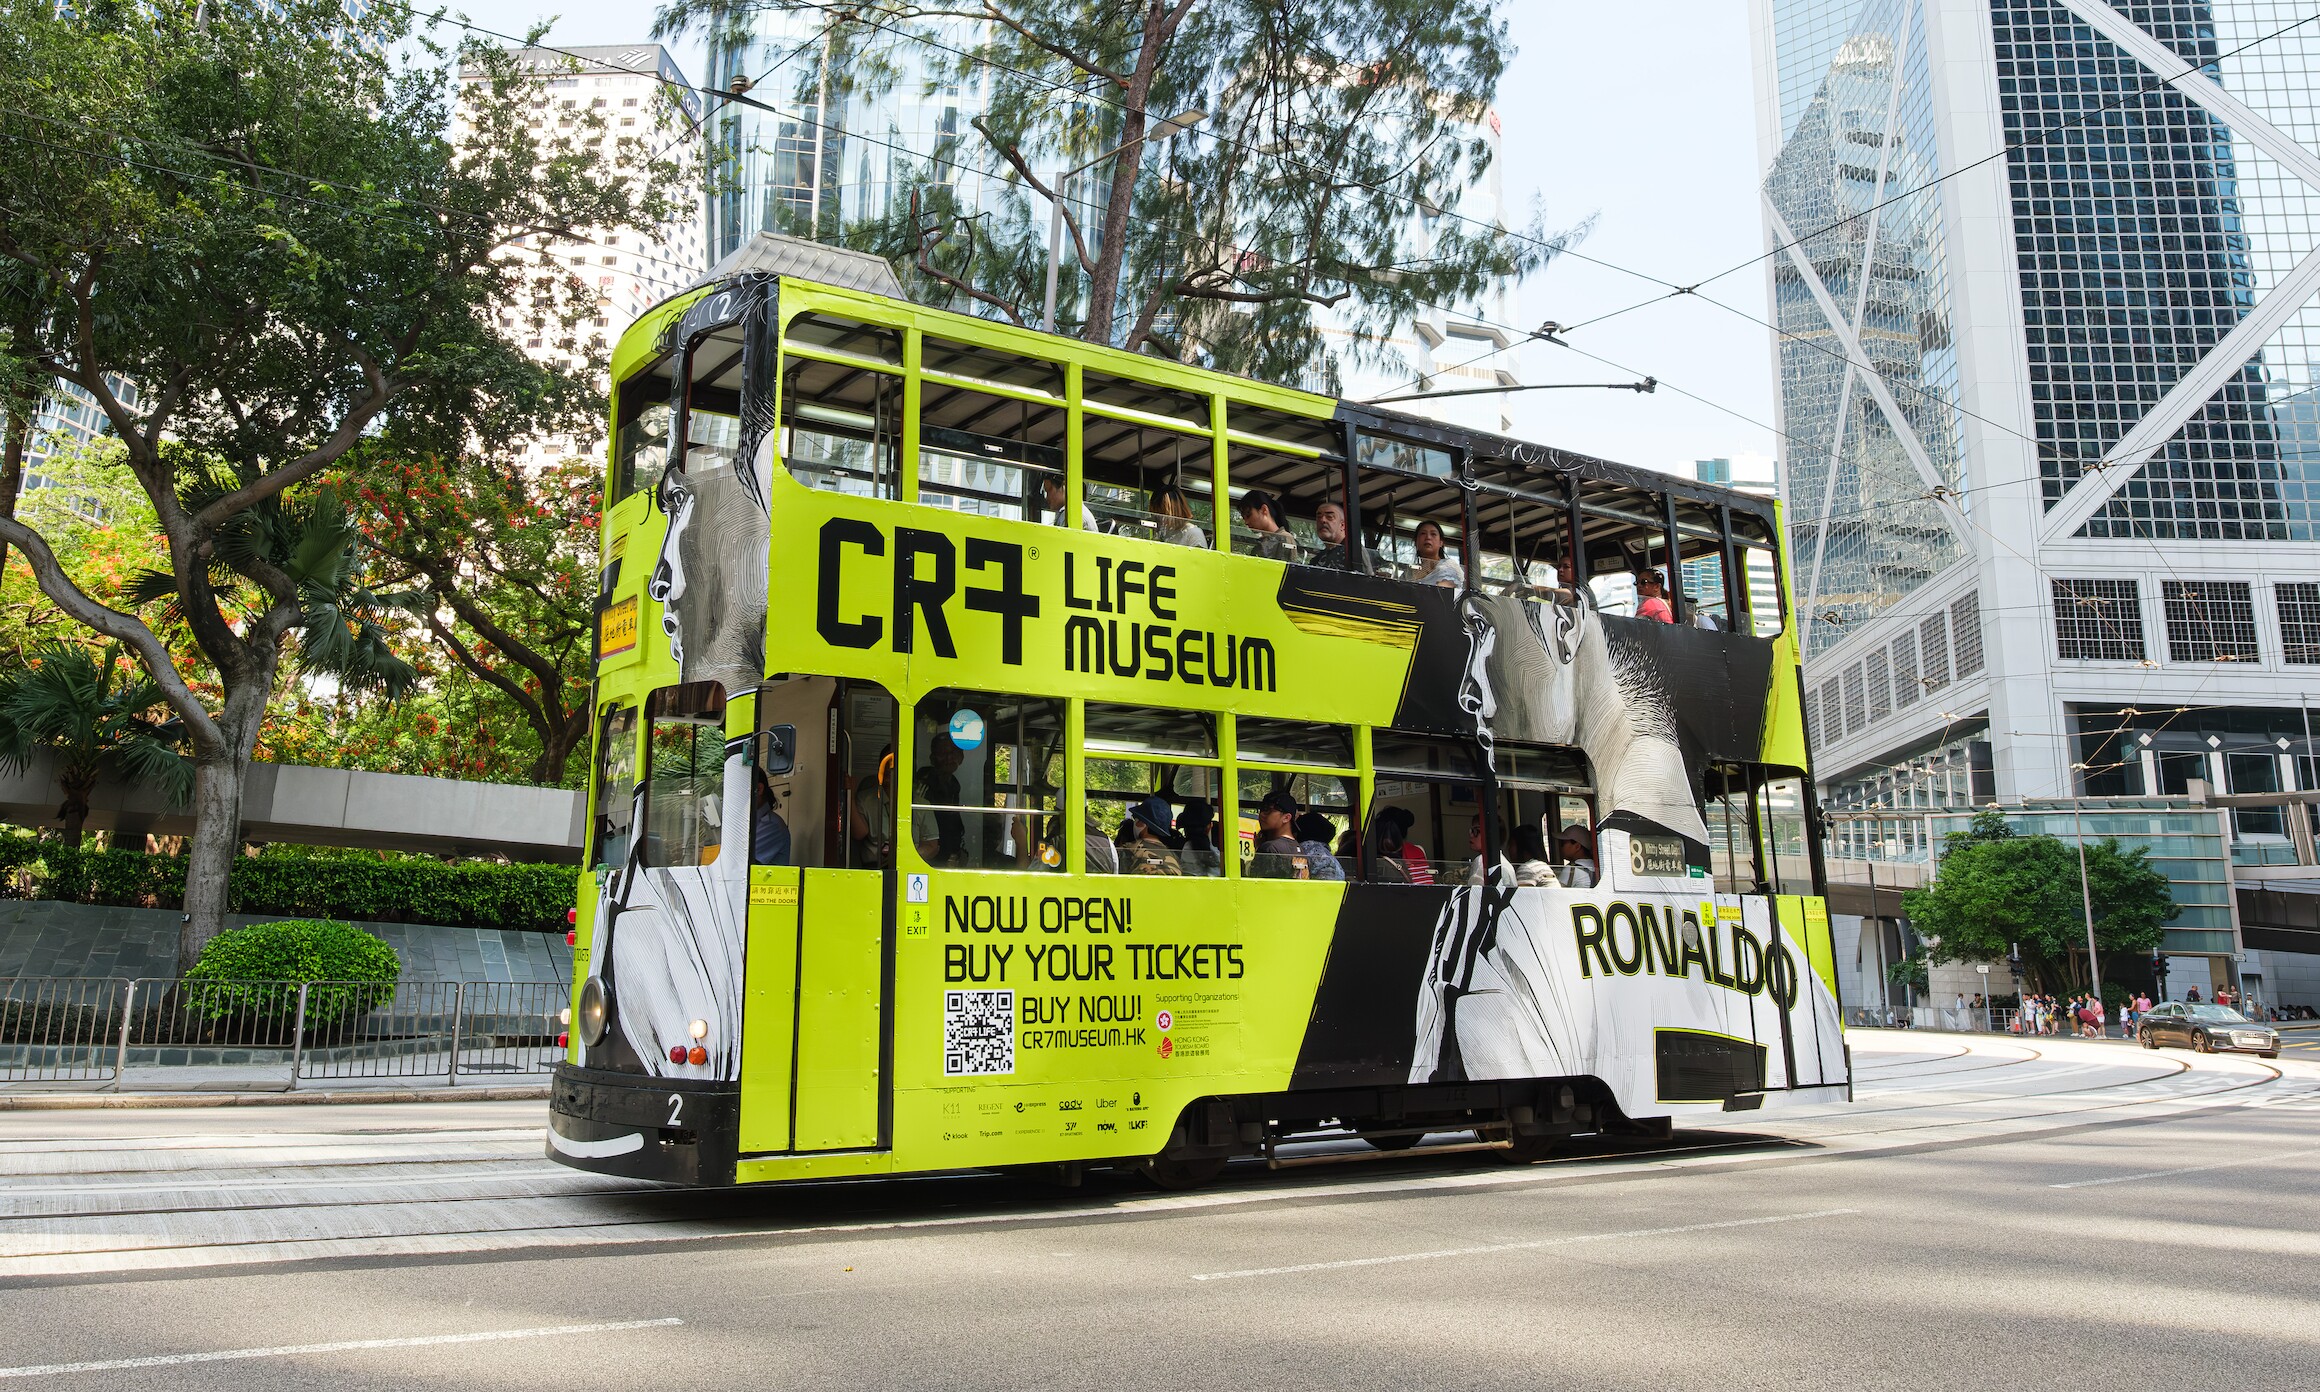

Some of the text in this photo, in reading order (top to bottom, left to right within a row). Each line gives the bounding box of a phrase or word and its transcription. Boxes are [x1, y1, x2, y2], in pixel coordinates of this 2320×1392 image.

[717, 293, 732, 321] 2
[1064, 551, 1177, 621] LIFE
[1064, 614, 1277, 692] MUSEUM
[1629, 839, 1645, 873] 8
[944, 895, 1132, 934] NOW OPEN!
[907, 926, 927, 935] EXIT
[944, 944, 1244, 982] BUY YOUR TICKETS
[1570, 901, 1798, 1011] RONALDO
[1022, 995, 1142, 1025] BUY NOW!
[1155, 993, 1193, 1004] Supporting
[963, 1026, 996, 1037] CR7 LIFE
[1022, 1028, 1146, 1050] CR7MUSEUM.HK
[1174, 1035, 1210, 1044] HONG KONG
[666, 1093, 684, 1126] 2
[943, 1102, 960, 1114] K11
[978, 1103, 1003, 1111] REGENT
[1095, 1099, 1118, 1109] Uber
[979, 1130, 1003, 1138] Trip.com
